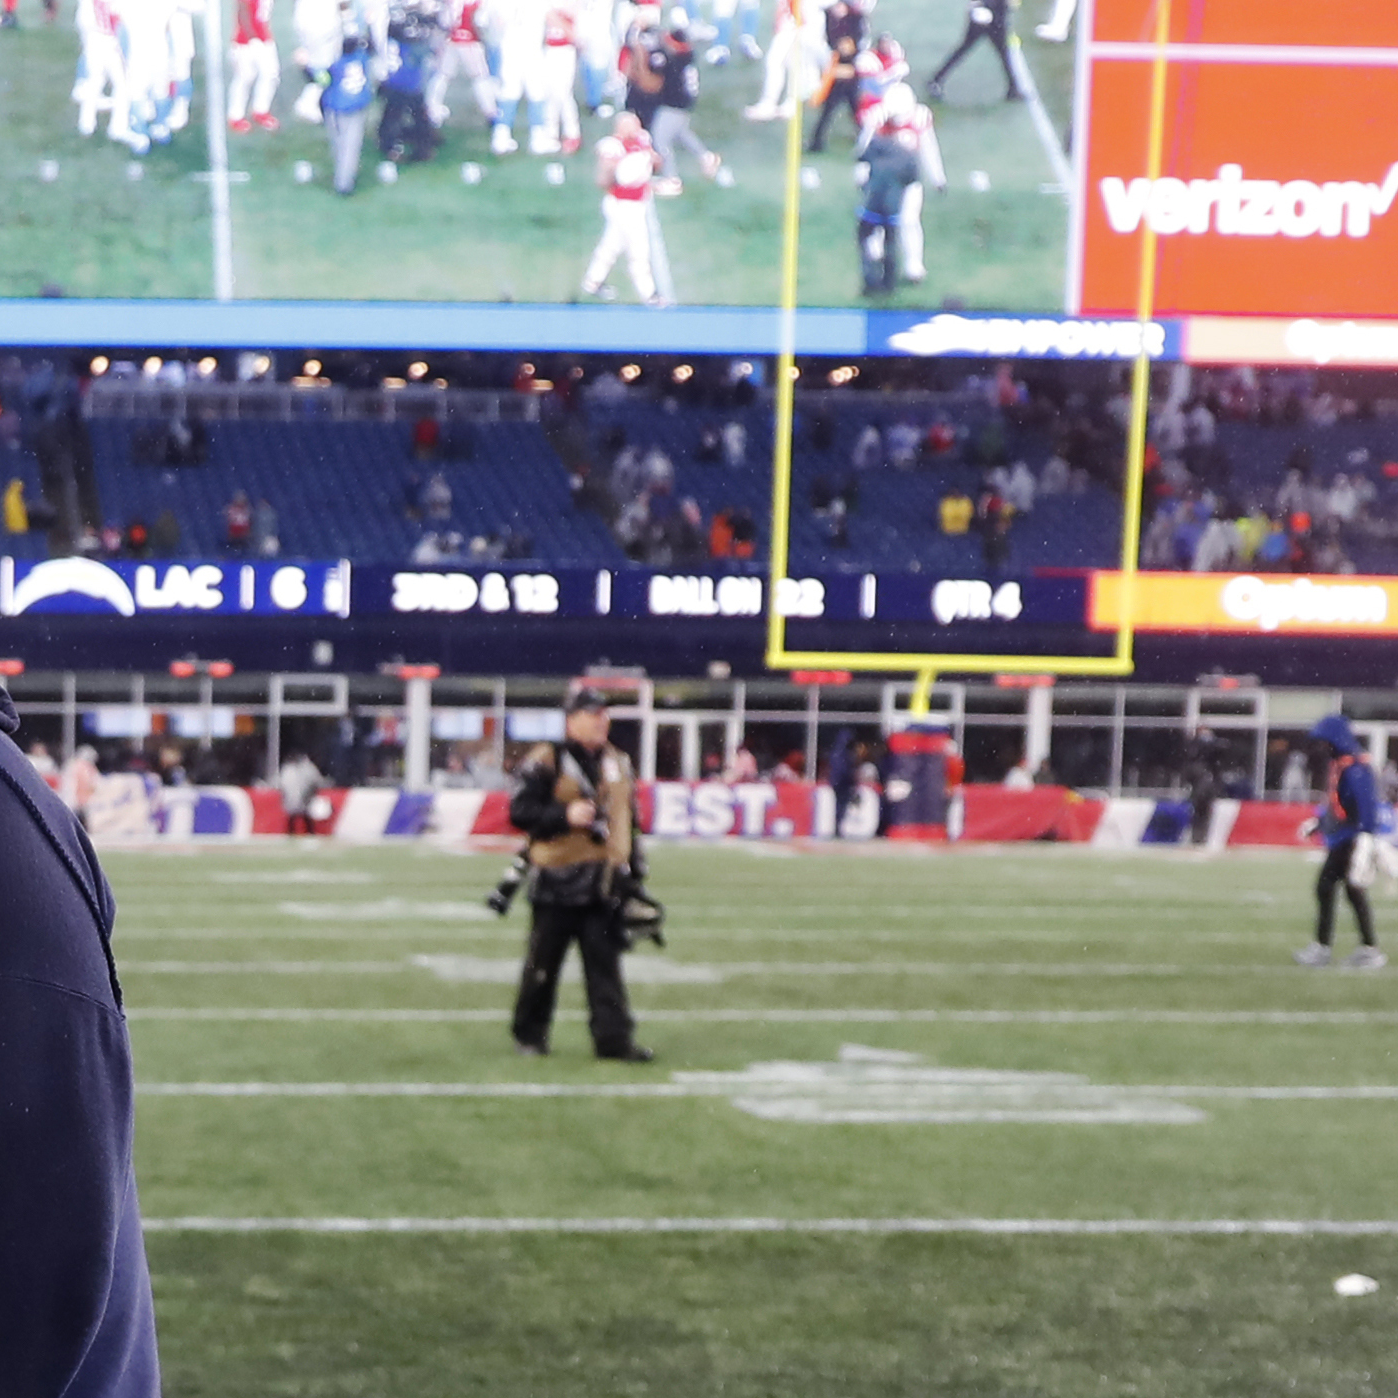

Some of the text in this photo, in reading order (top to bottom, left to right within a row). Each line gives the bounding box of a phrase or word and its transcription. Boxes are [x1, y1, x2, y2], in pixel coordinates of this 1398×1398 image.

[1100, 163, 1371, 237] verizon
[135, 565, 223, 609] LAC
[992, 582, 1022, 618] 4
[651, 781, 795, 840] EST.
